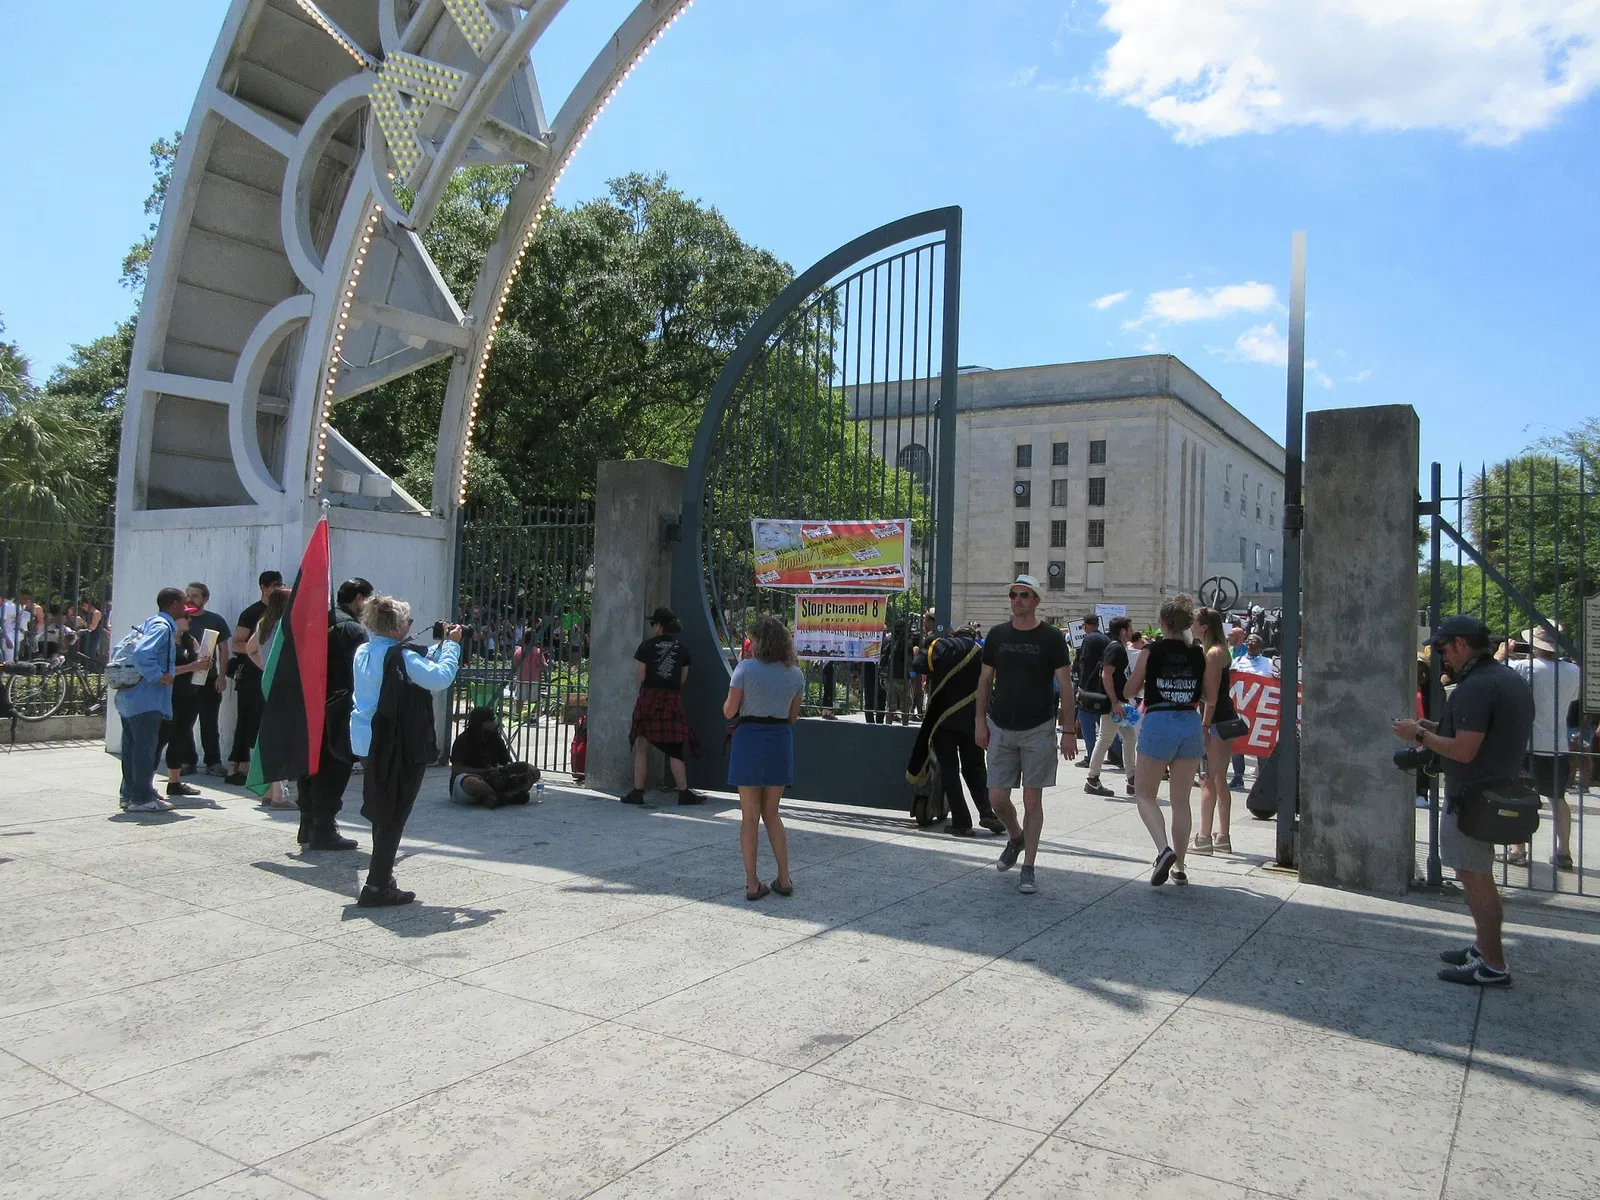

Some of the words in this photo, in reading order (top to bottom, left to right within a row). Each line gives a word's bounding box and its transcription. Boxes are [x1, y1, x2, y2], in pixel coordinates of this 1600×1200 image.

[774, 546, 798, 556] Black
[823, 535, 842, 545] host
[801, 598, 823, 618] Stop
[825, 602, 867, 616] Channel
[872, 599, 879, 618] 8
